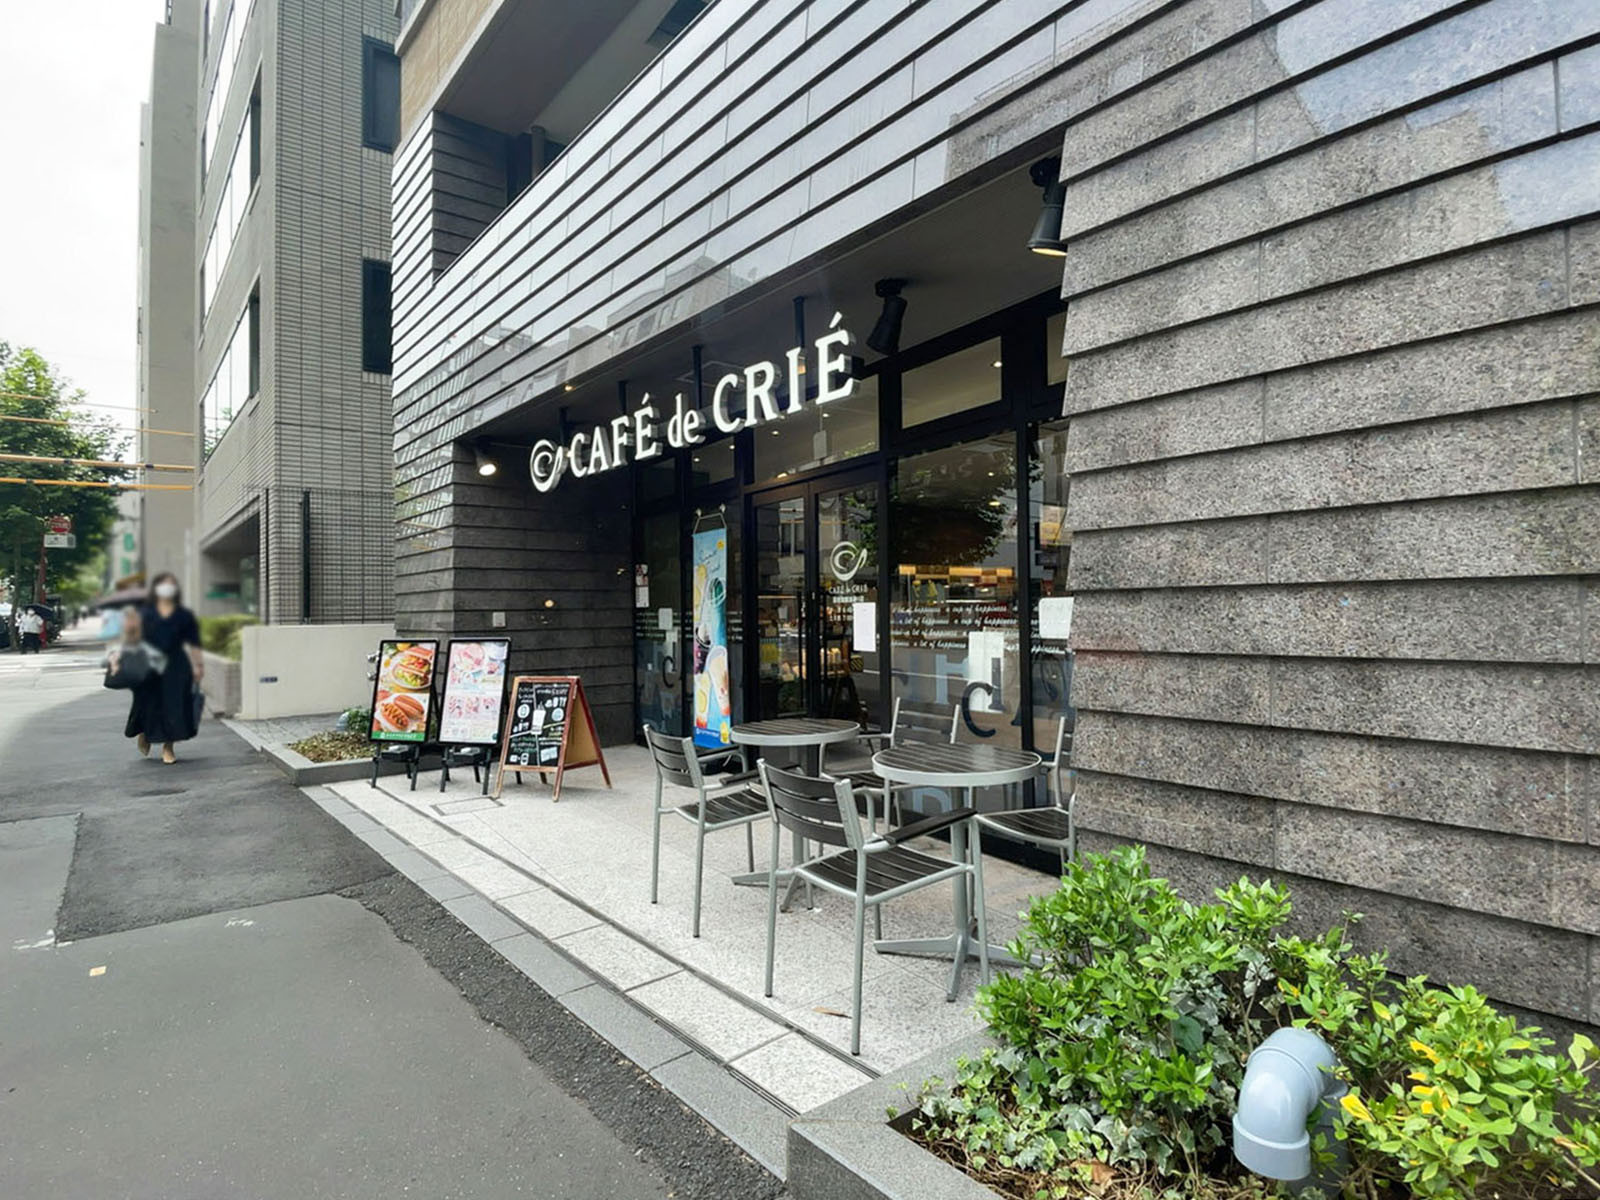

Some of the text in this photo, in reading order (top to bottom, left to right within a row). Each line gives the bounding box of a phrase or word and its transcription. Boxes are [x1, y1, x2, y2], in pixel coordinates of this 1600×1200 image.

[569, 310, 856, 478] CAFÉ de CRIÉ
[975, 604, 1007, 614] happiness
[983, 616, 1018, 627] happiness
